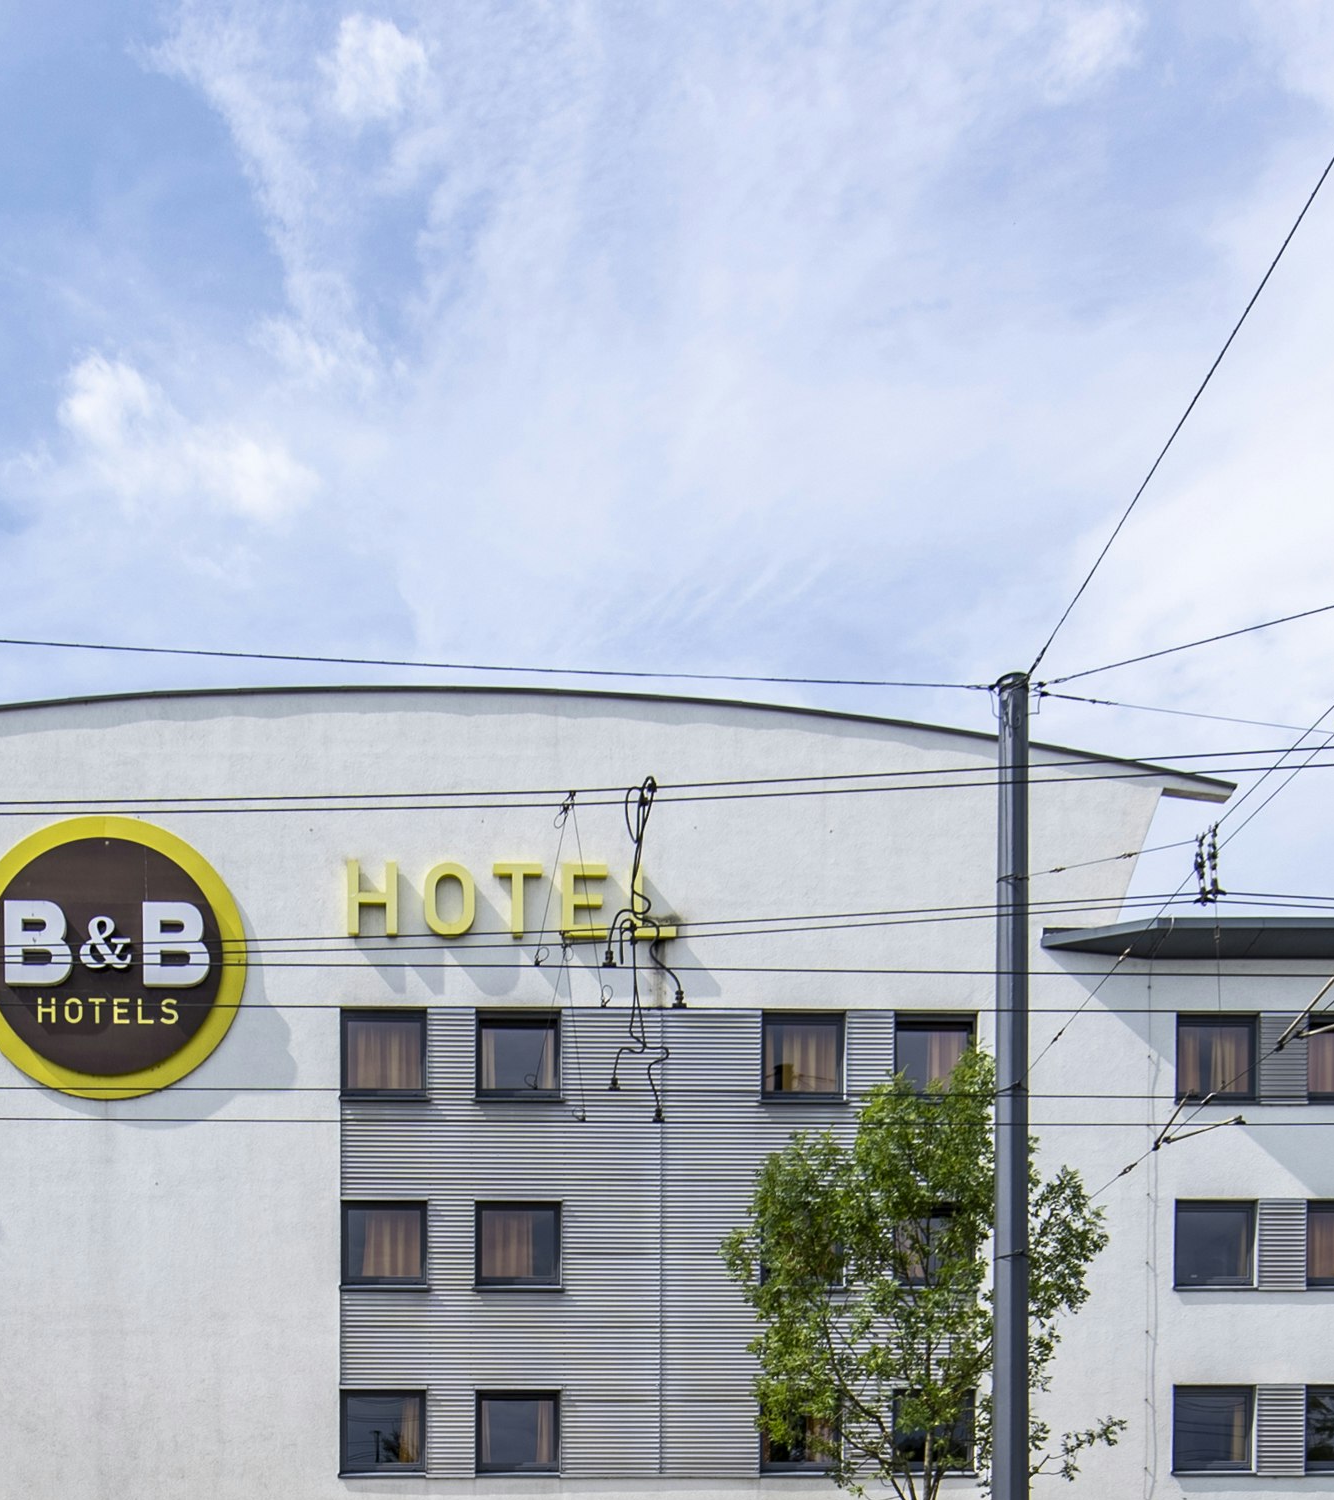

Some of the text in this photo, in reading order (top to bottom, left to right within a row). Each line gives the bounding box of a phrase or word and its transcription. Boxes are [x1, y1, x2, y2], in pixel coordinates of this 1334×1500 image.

[346, 859, 677, 940] HOTEL
[3, 899, 211, 988] B&B
[37, 997, 179, 1025] HOTELS
